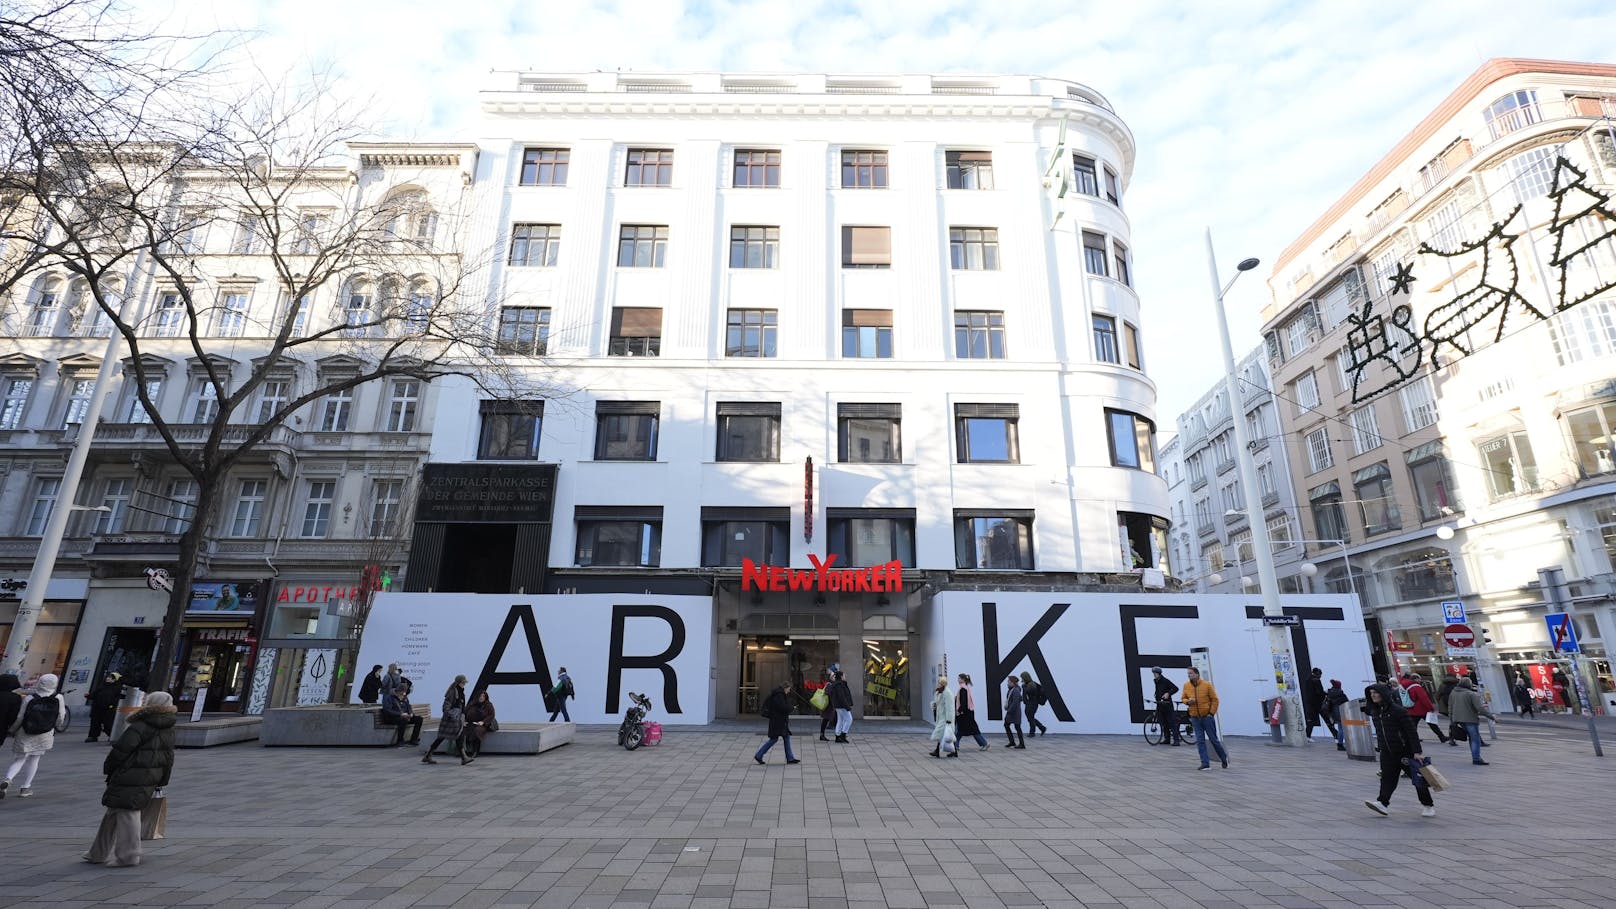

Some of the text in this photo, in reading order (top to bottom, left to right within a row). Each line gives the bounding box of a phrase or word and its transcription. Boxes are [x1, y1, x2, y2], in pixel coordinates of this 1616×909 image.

[430, 477, 548, 488] ZENTRALSPARKASSE
[426, 491, 547, 502] DER GEMEINDE WIEN
[199, 629, 251, 641] TRAFIK
[874, 684, 889, 696] SALE
